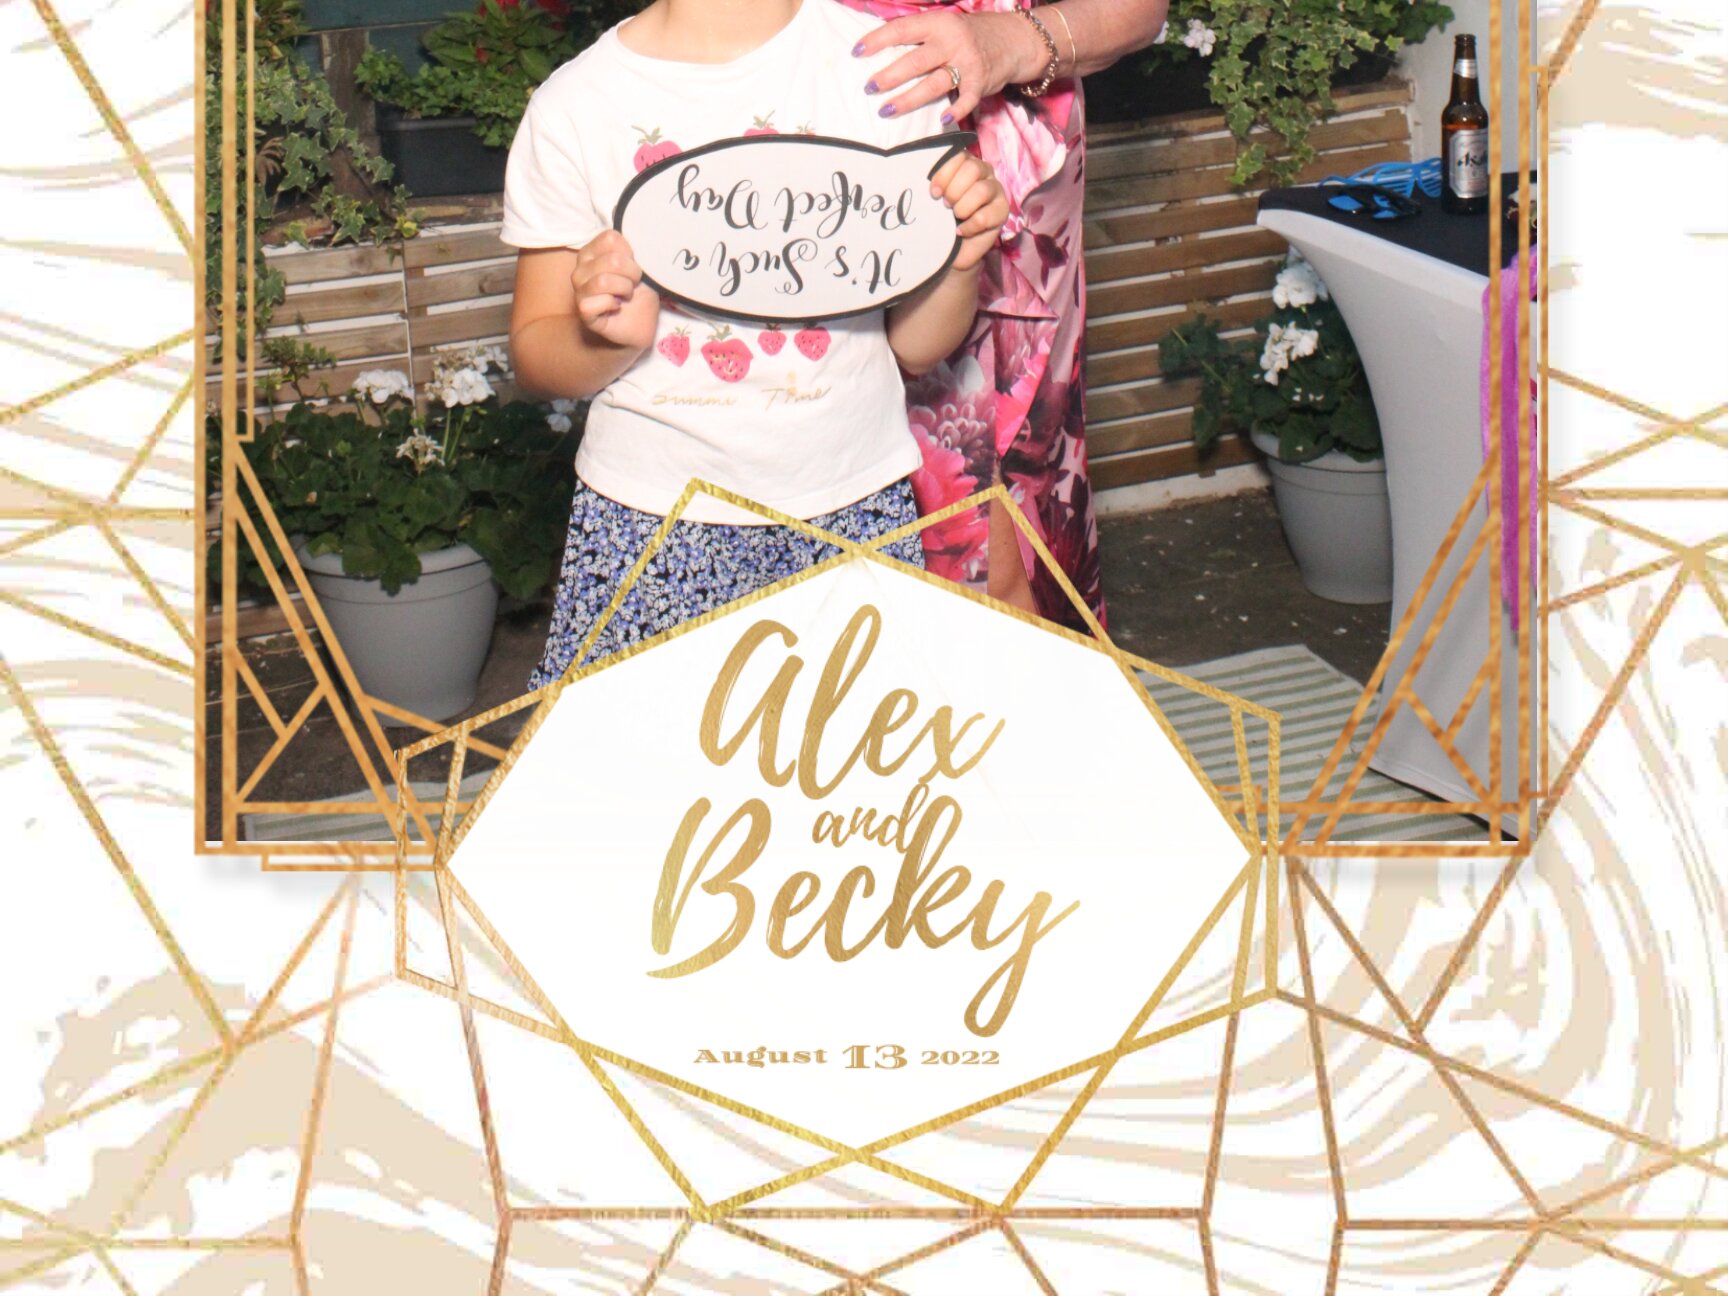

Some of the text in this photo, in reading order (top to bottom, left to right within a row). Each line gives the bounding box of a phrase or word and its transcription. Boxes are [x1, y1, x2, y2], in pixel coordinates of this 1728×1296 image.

[669, 163, 917, 240] Perfect Day
[672, 237, 902, 296] It's Such a
